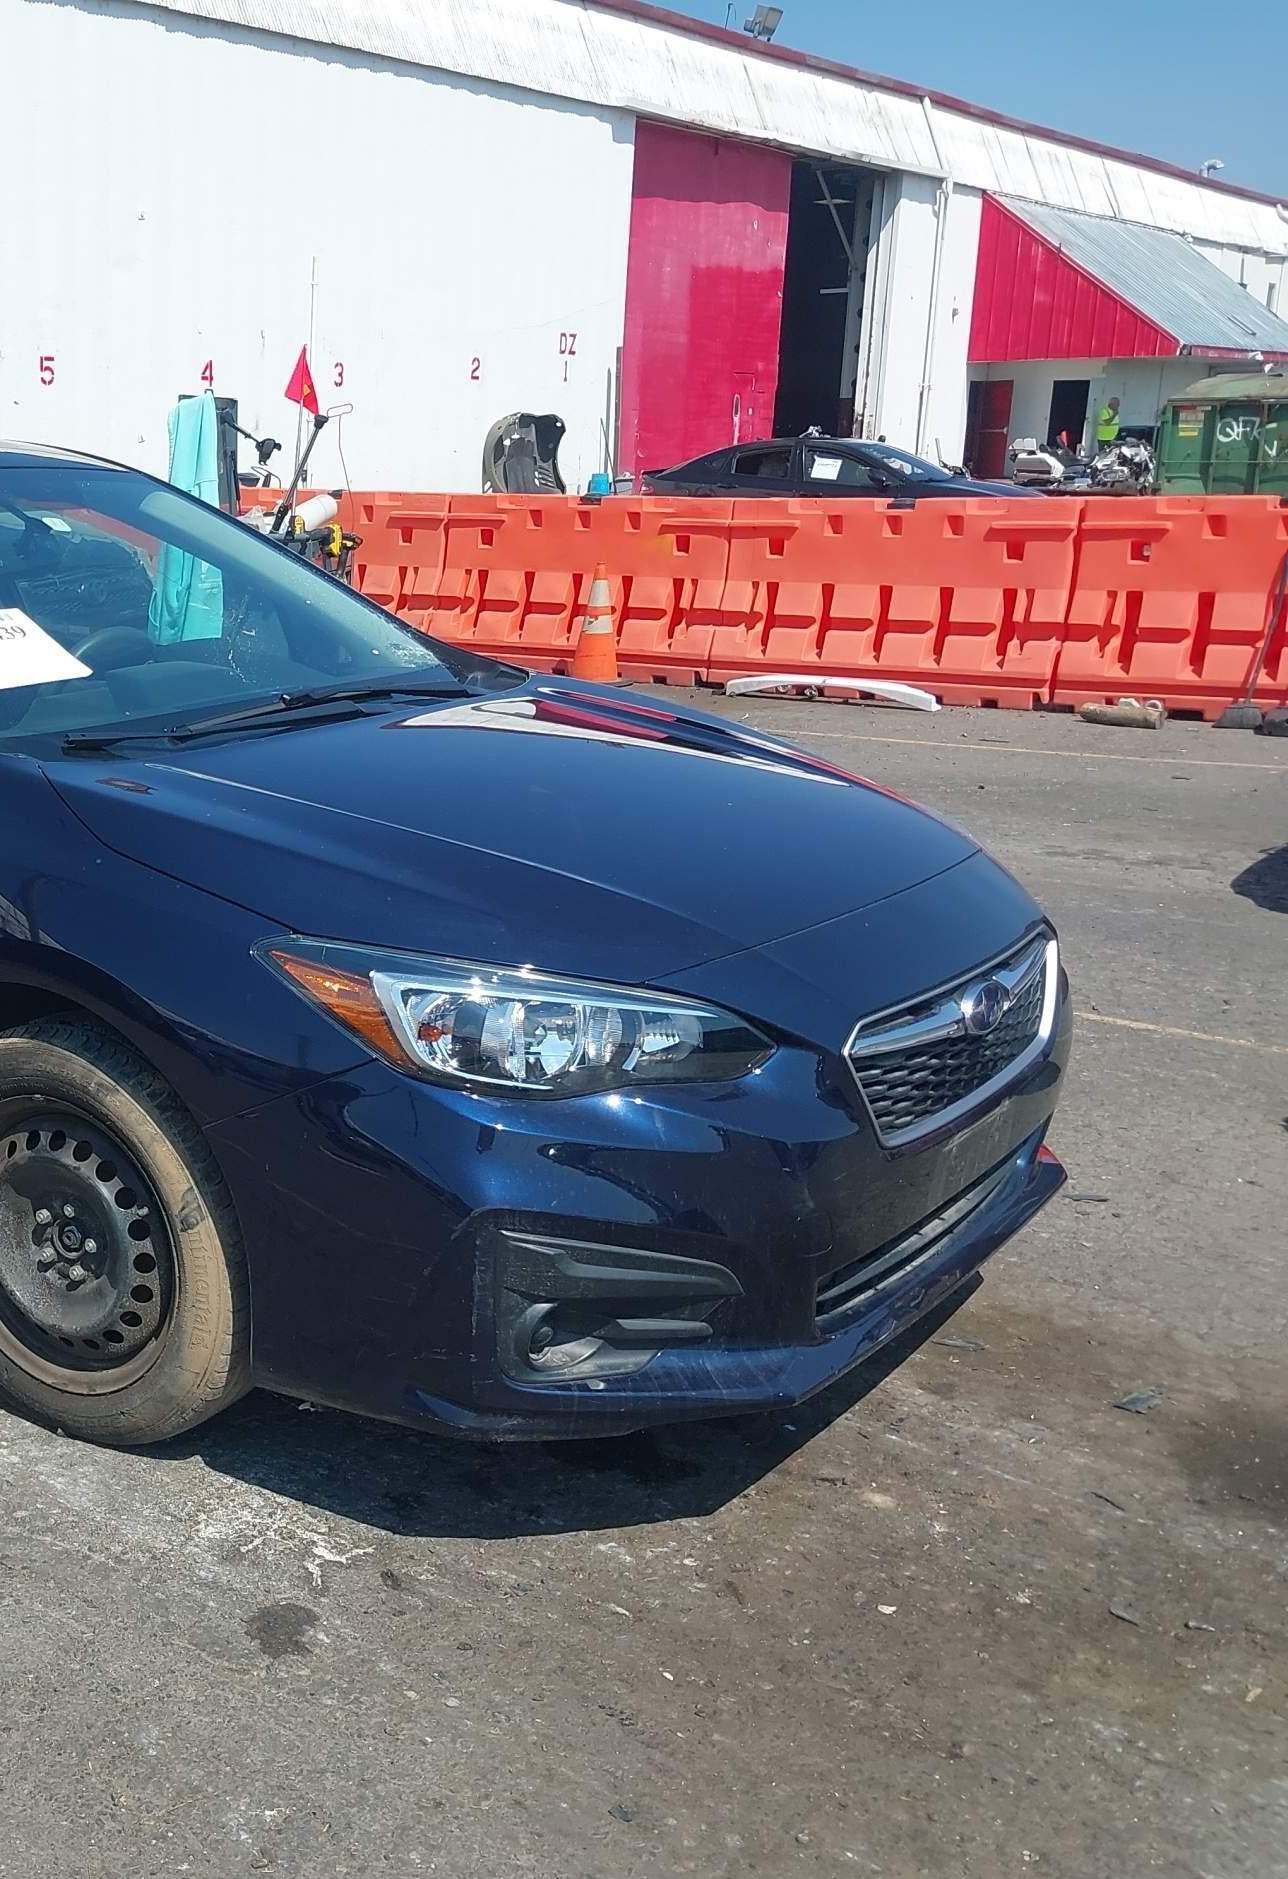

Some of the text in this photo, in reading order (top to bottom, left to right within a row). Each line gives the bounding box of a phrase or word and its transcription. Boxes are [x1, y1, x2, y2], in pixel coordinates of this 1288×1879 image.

[559, 332, 577, 355] DZ
[39, 355, 55, 385] 5
[200, 360, 214, 387] 4
[333, 362, 344, 387] 3
[470, 357, 481, 381] 2
[563, 360, 568, 382] 1
